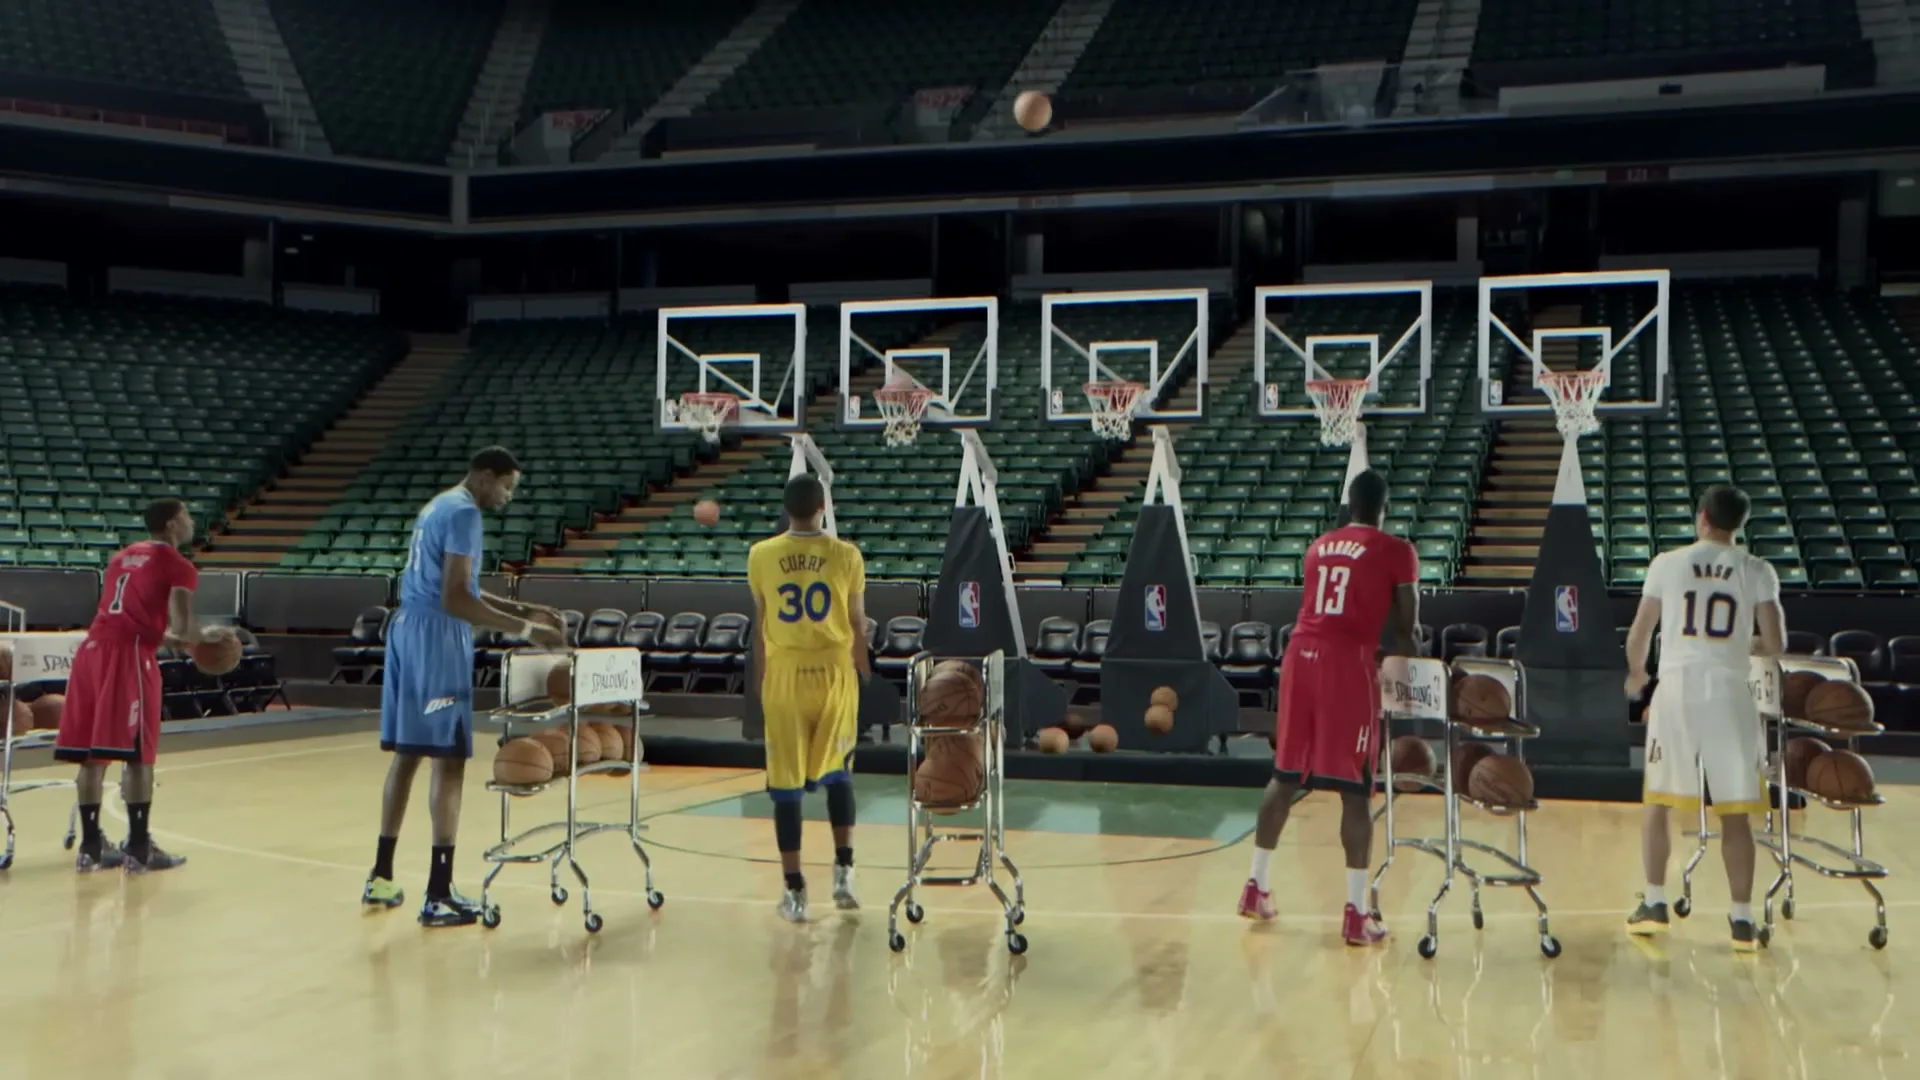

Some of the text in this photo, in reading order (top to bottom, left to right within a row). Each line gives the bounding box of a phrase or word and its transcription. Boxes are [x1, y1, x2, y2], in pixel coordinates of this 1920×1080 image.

[778, 553, 827, 574] CURRY
[108, 572, 131, 614] 1
[777, 581, 832, 623] 30
[1315, 565, 1350, 615] 13
[1682, 590, 1738, 638] 10
[1355, 724, 1370, 753] H
